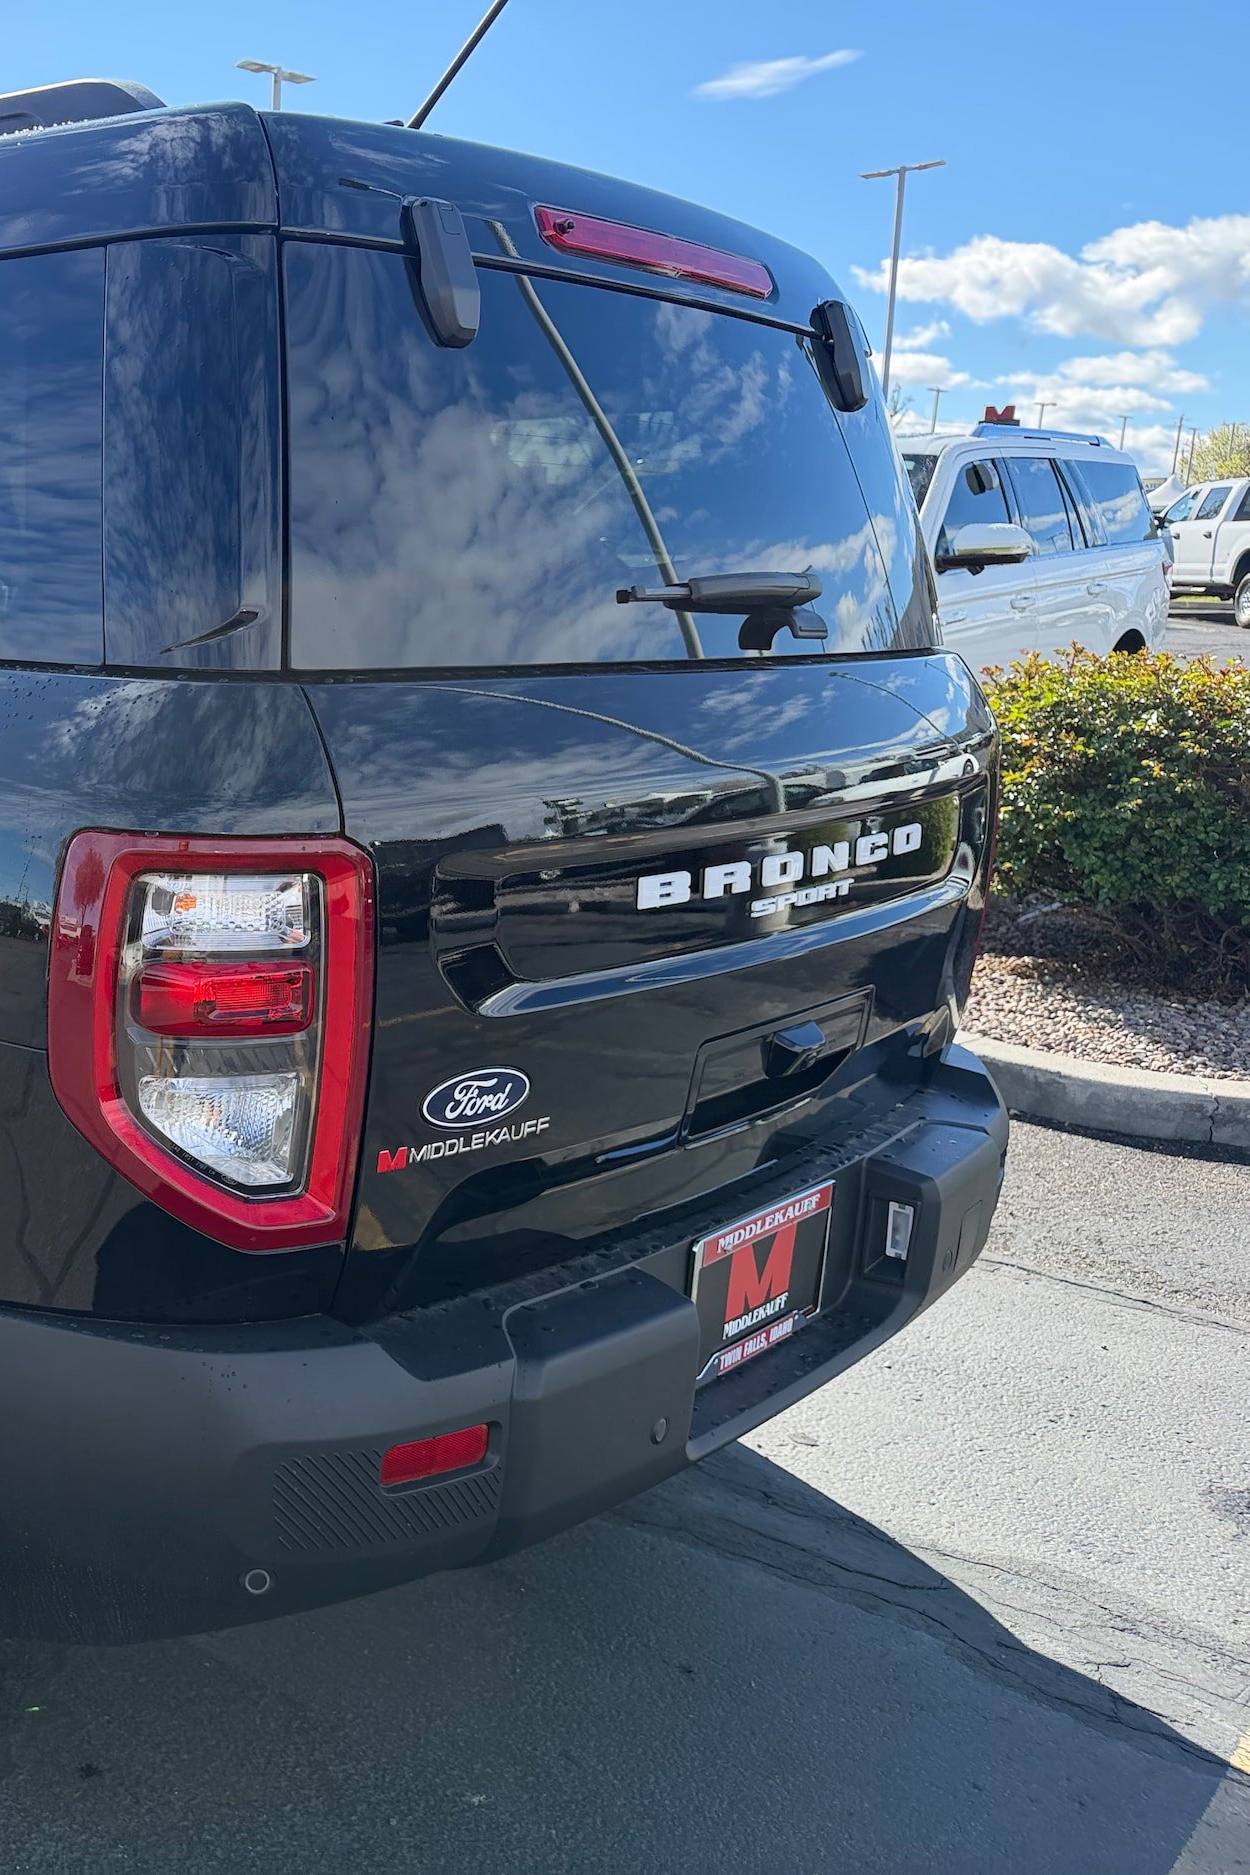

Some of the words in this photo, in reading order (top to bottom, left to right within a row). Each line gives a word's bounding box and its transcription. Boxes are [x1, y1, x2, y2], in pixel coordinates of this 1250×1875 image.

[637, 822, 922, 911] BRONCO
[750, 878, 855, 918] SPORT
[444, 1077, 513, 1120] Ford
[408, 1116, 551, 1164] MIDDLEKAUFF
[717, 1193, 821, 1254] MIDDLEKAUFF
[725, 1222, 798, 1322] M
[723, 1291, 789, 1340] MIDDLEKAUFF
[719, 1346, 743, 1371] TWIN
[743, 1332, 768, 1357] FALLS,
[769, 1317, 794, 1343] IDAHO
